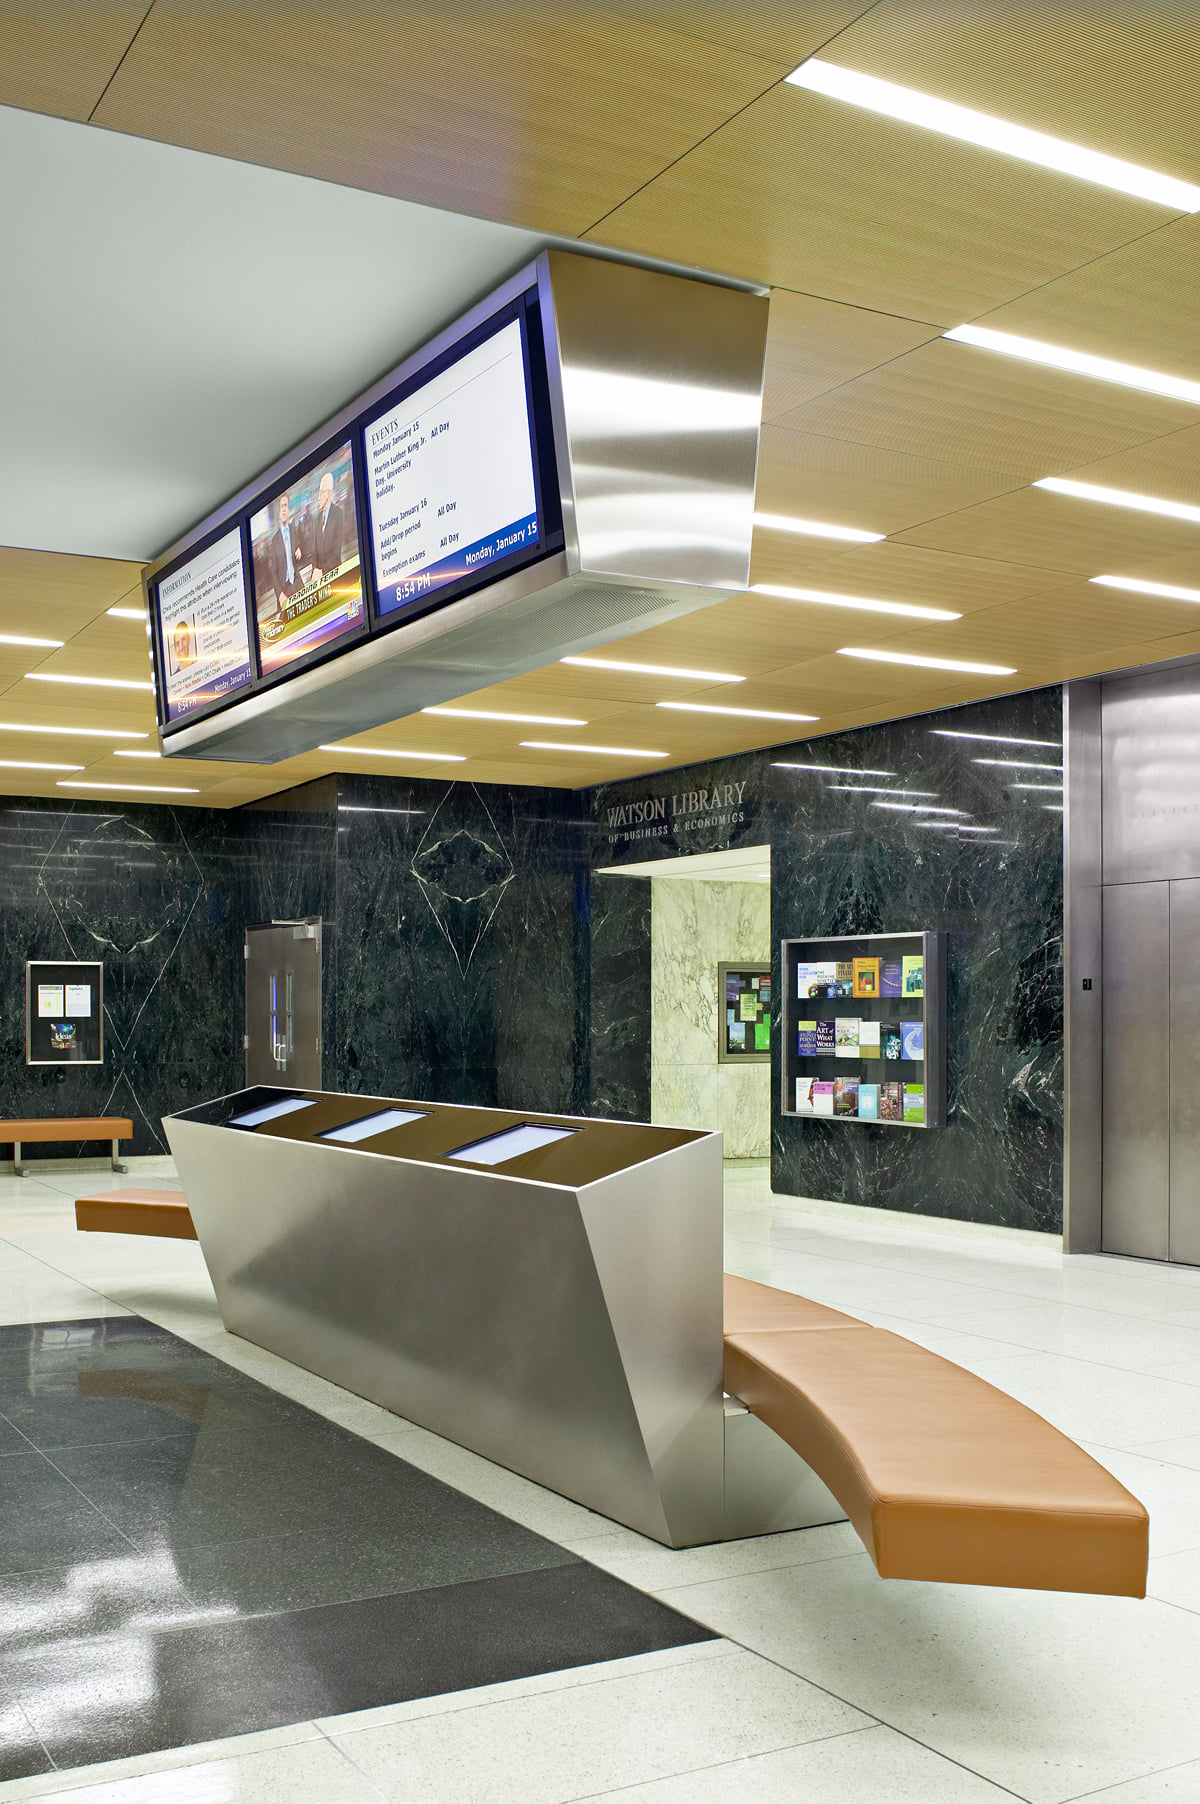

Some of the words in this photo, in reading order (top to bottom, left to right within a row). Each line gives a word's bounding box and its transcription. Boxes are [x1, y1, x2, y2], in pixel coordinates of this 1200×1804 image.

[371, 417, 398, 445] EVENTS
[372, 442, 391, 458] Monday
[391, 428, 411, 446] January
[412, 420, 419, 432] 15
[430, 426, 438, 439] All
[439, 421, 450, 433] Day
[374, 460, 389, 476] Martin
[390, 449, 406, 465] Luther
[407, 441, 419, 454] King
[386, 459, 411, 479] University
[376, 483, 395, 499] holiday.
[379, 516, 398, 532] Tuesday
[399, 504, 419, 520] January
[420, 497, 427, 509] 16
[436, 505, 445, 518] All
[446, 501, 456, 512] Day
[404, 519, 421, 537] period
[439, 536, 447, 548] All
[448, 533, 459, 543] Day
[465, 545, 494, 565] Monday,
[495, 529, 525, 551] January
[526, 519, 537, 536] 15
[381, 547, 397, 561] begins
[382, 559, 408, 577] Exemption
[409, 549, 425, 564] exams
[162, 569, 191, 597] INFORMATION
[395, 579, 415, 602] 8:54
[416, 571, 430, 591] PM
[286, 606, 295, 620] THE
[295, 592, 317, 614] TRADER'S
[177, 698, 188, 713] 8:54
[606, 797, 665, 828] WATSON
[671, 781, 747, 817] LIBRARY
[608, 834, 619, 844] OF
[624, 824, 668, 841] BUSINESS
[673, 823, 680, 833] &
[685, 811, 744, 831] ECONOMICS
